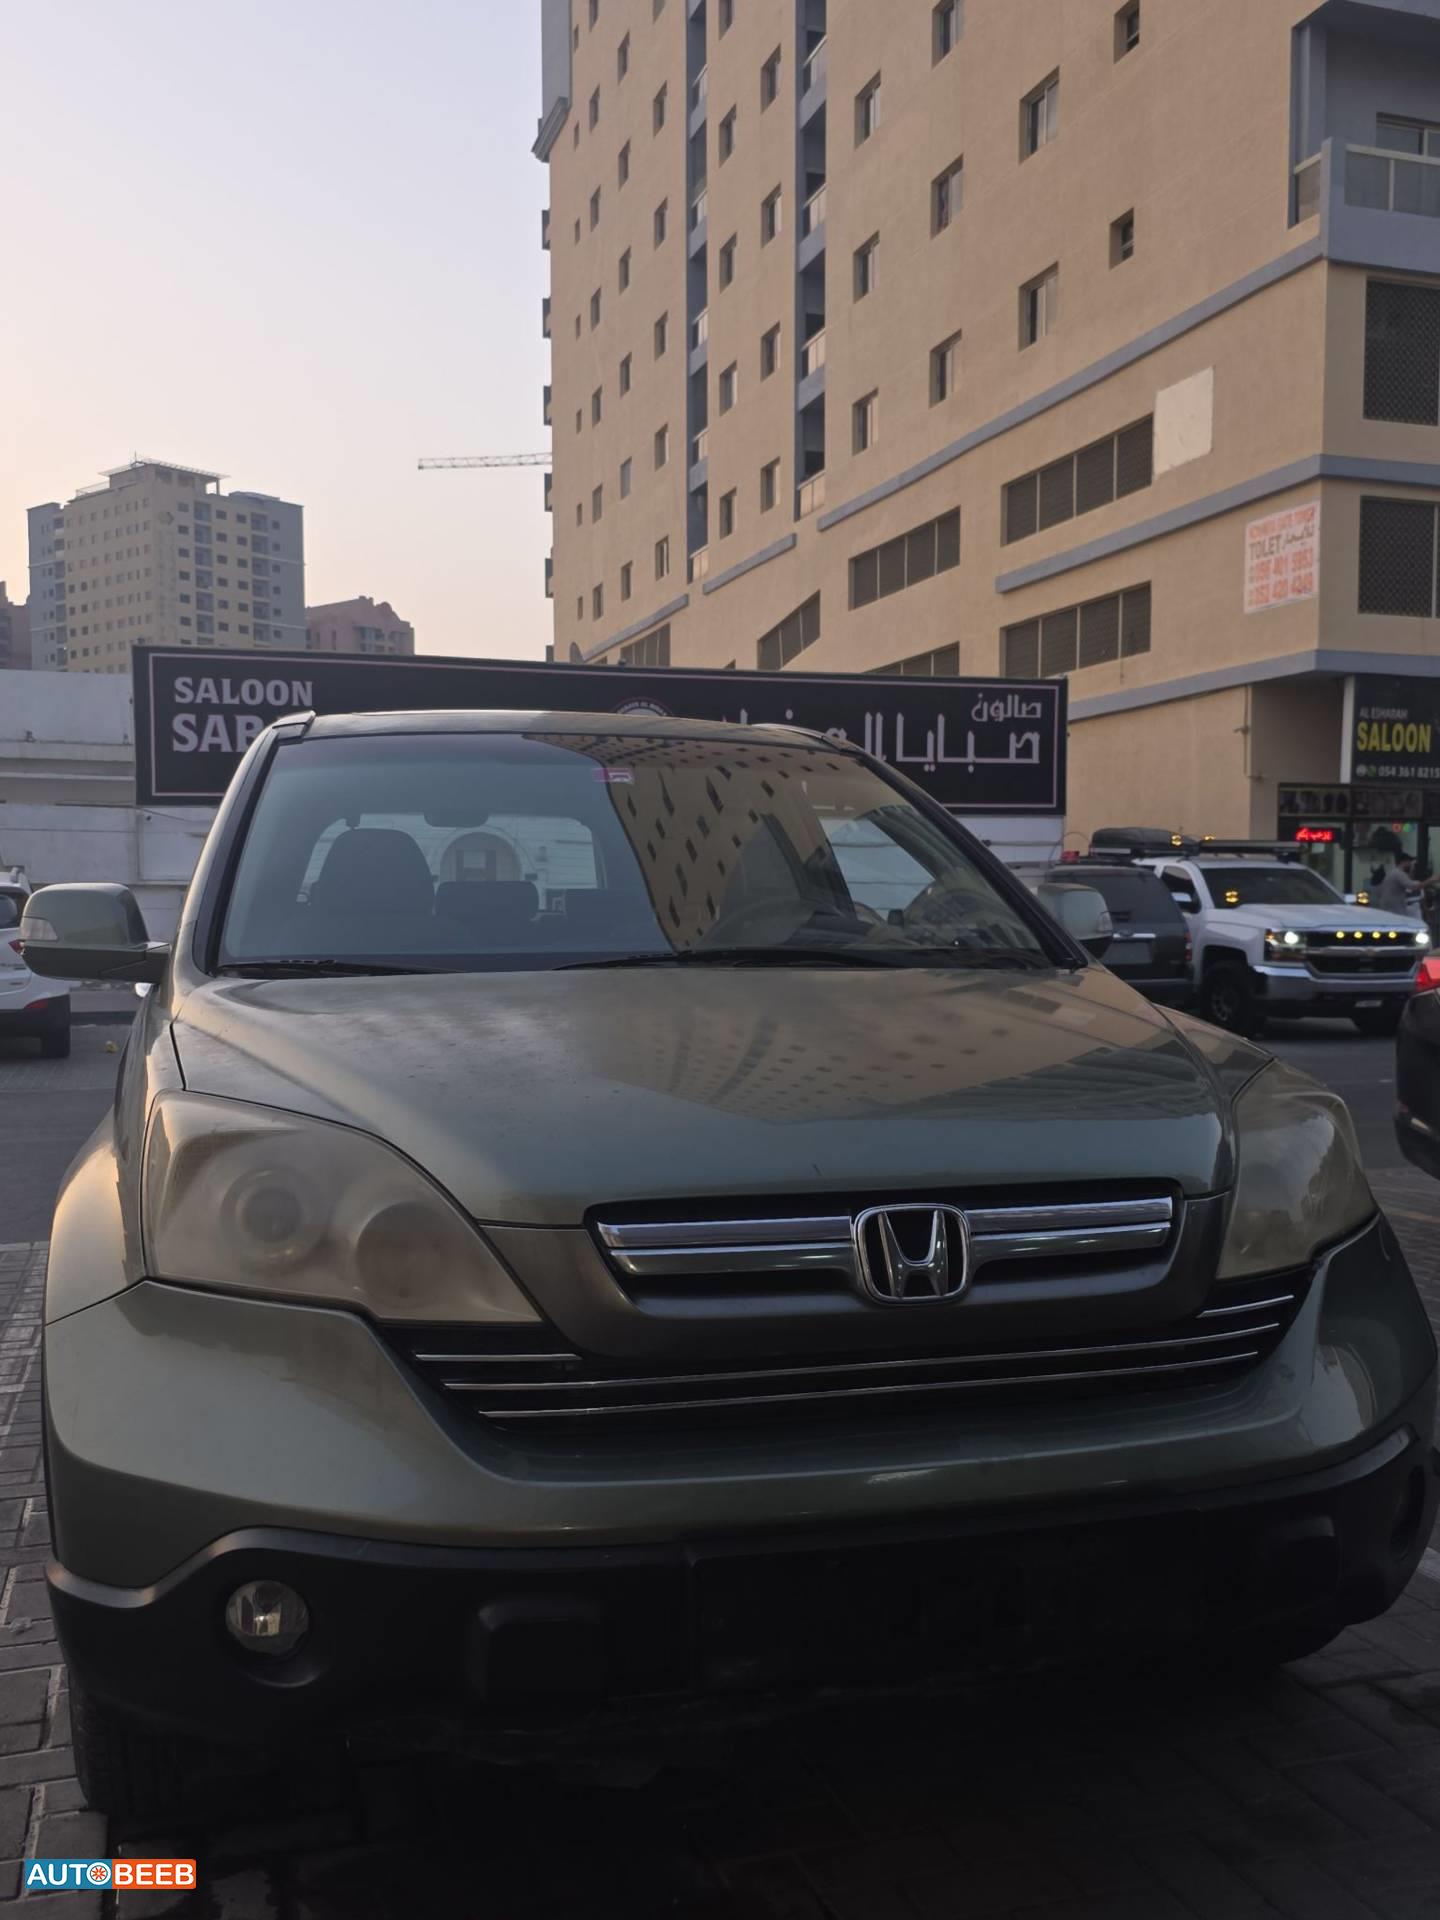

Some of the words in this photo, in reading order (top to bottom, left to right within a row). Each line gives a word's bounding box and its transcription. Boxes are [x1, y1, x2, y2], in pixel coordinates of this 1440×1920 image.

[174, 676, 313, 707] SALOON
[971, 692, 1042, 722] صالون
[896, 712, 1040, 773] صبايا
[1357, 721, 1431, 753] SALOON
